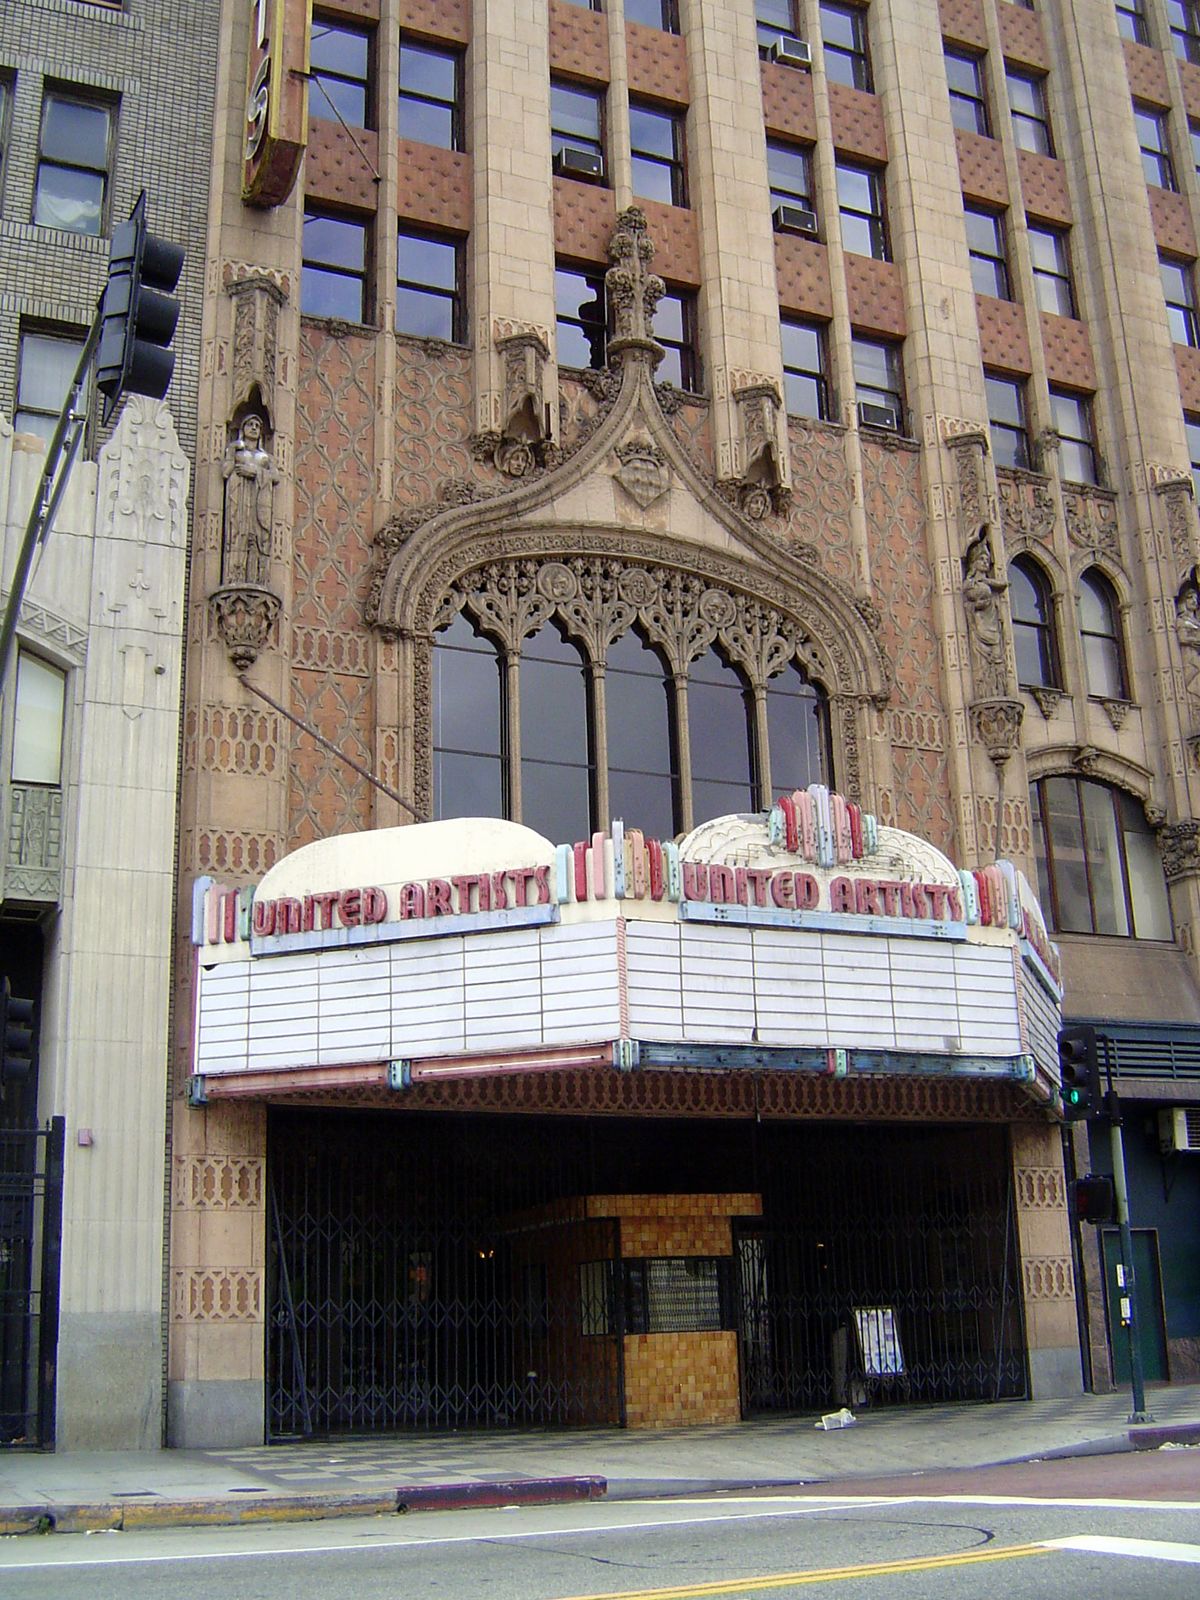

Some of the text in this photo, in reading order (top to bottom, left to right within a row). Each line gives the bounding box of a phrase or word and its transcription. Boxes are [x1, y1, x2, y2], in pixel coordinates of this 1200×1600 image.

[253, 865, 551, 937] UNITED ARTISTS
[682, 863, 963, 922] UNITED ARTISTS
